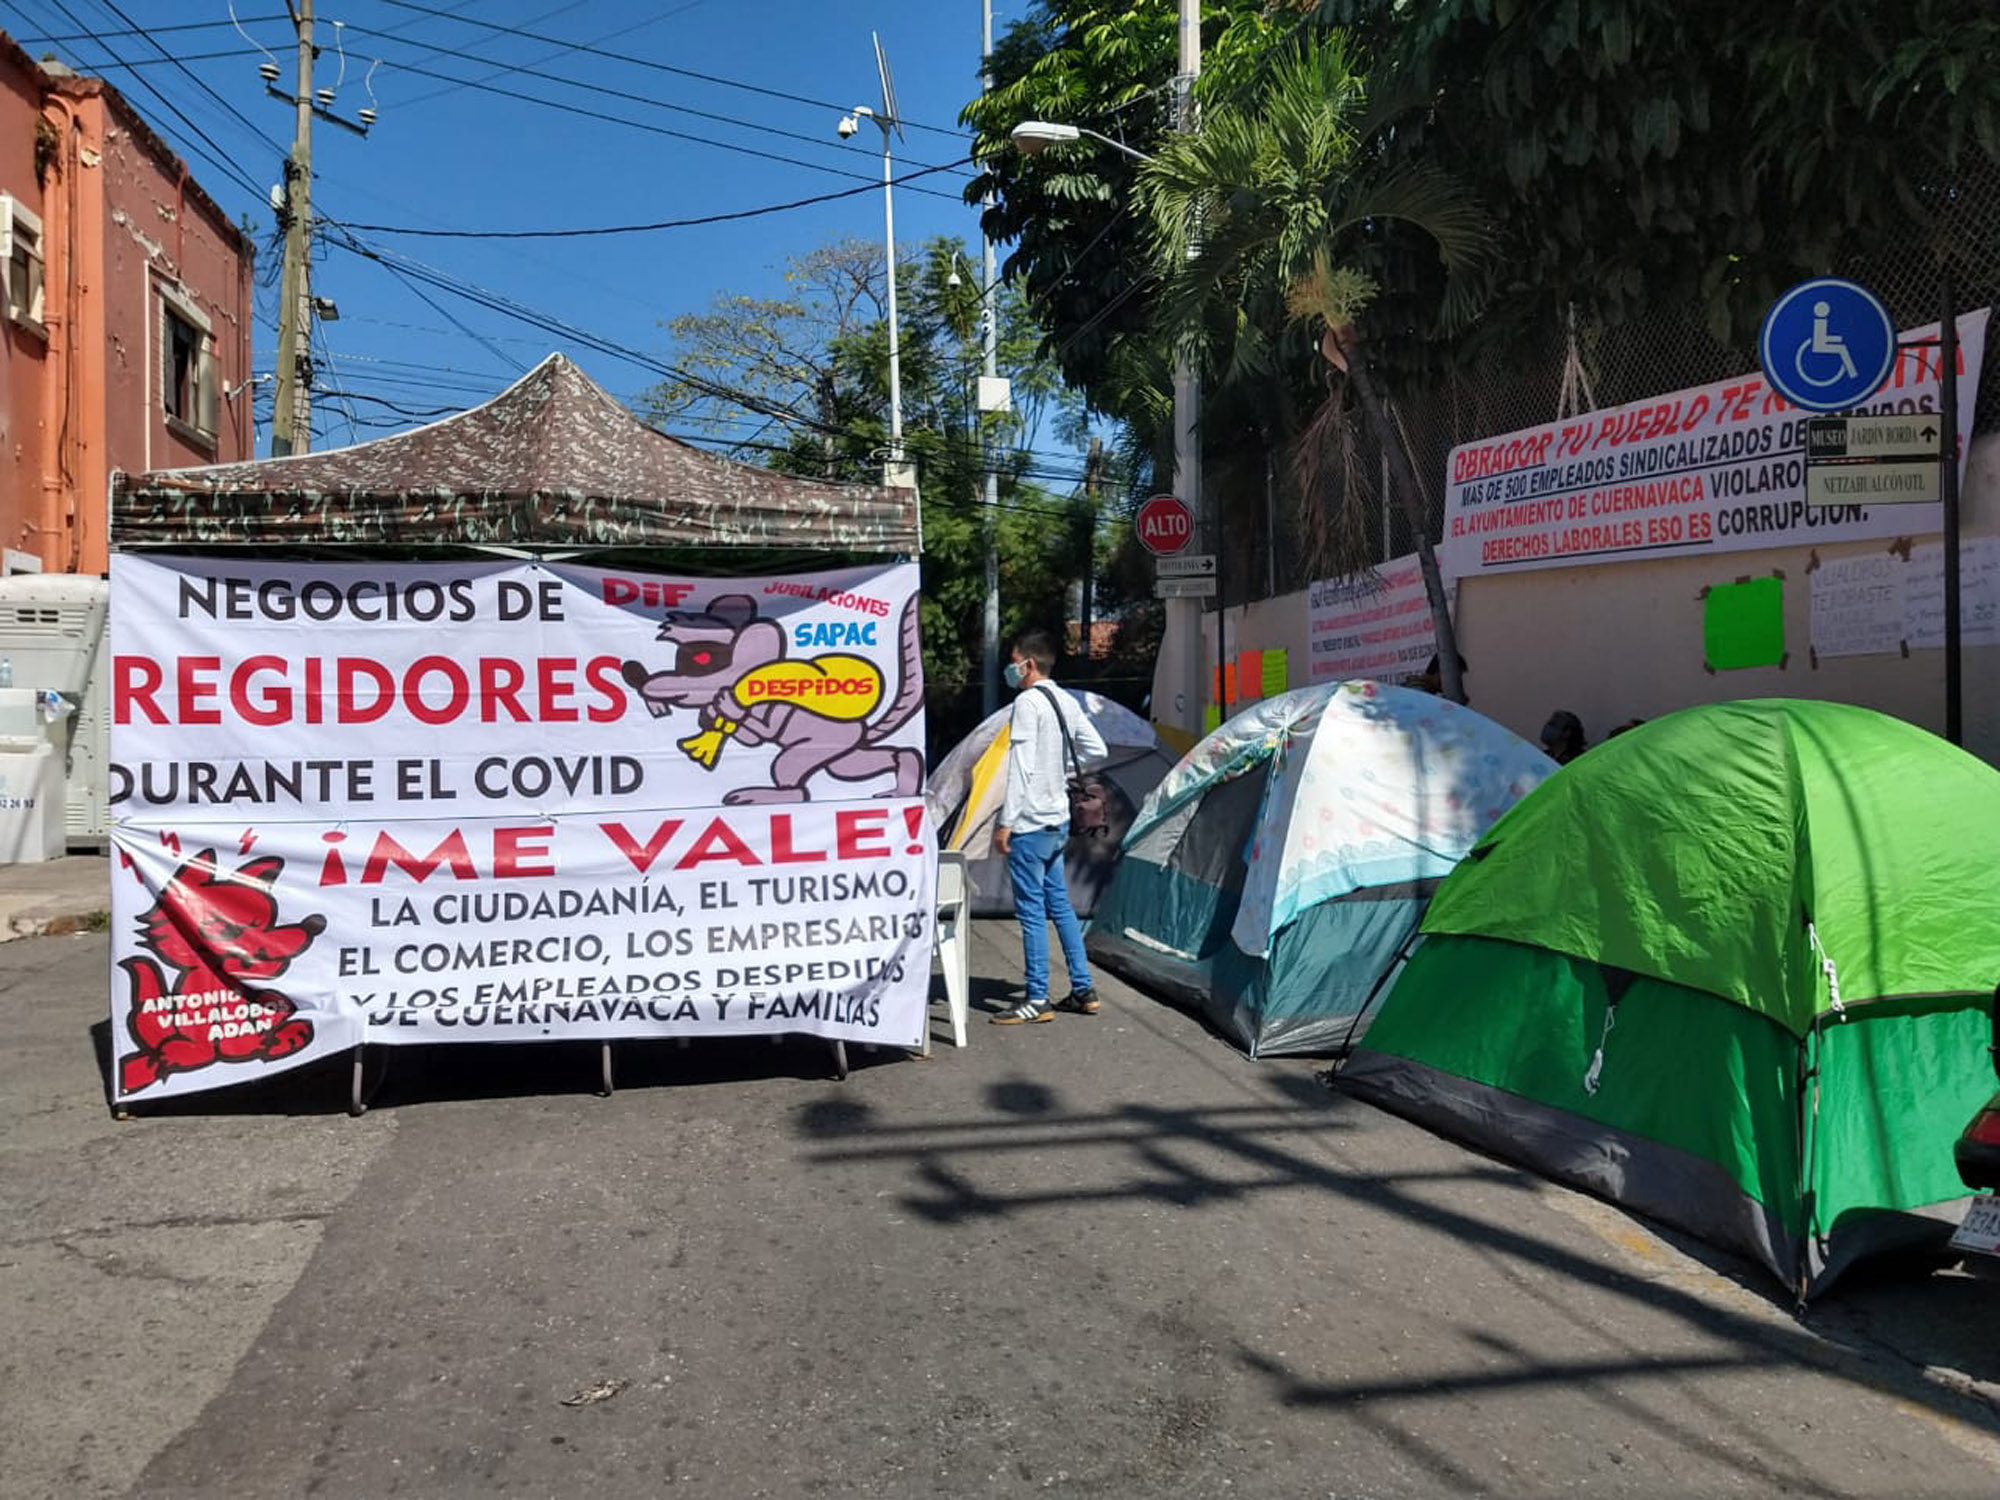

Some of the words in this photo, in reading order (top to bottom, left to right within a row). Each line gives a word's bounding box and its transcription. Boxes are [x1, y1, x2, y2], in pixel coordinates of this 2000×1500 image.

[1453, 431, 1554, 483] OBRADOR
[1556, 421, 1592, 459] TU
[1592, 394, 1710, 451] PUEBLO
[1715, 381, 1763, 425] TE
[1811, 428, 1847, 447] MUSEO
[1886, 425, 1918, 444] BORDA
[1486, 480, 1503, 501] DE
[1505, 474, 1527, 499] 500
[1530, 456, 1615, 495] EMPLEADOS
[1620, 425, 1773, 477] SINDICALIZADOS
[1468, 498, 1563, 534] AYUNTAMIENTO
[1568, 495, 1586, 520] DE
[1591, 475, 1705, 515] CUERNAVACA
[1710, 459, 1807, 499] VIOLARO
[1145, 513, 1188, 537] ALTO
[1482, 535, 1549, 562] DERECHOS
[1553, 520, 1642, 554] LABORALES
[1648, 515, 1682, 542] ESO
[1688, 512, 1711, 538] ES
[178, 575, 476, 622] NEGOCIOS
[499, 580, 565, 622] DE
[795, 621, 877, 647] SAPAC
[113, 655, 628, 727] REGIDORES
[109, 760, 375, 805] DURANTE
[397, 760, 457, 801] EL
[474, 756, 644, 799] COVID
[319, 825, 556, 887] ¡ME
[599, 805, 925, 875] VALE!
[371, 896, 421, 927] LA
[433, 877, 685, 925] CIUDADANÍA,
[700, 881, 738, 910] EL
[748, 869, 916, 906] TURISMO,
[339, 946, 380, 977] EL
[394, 934, 611, 975] COMERCIO,
[627, 928, 693, 959] LOS
[350, 993, 377, 1007] Y
[387, 986, 459, 1009] LOS
[474, 970, 702, 1006] EMPLEADOS
[368, 1008, 418, 1027] DE
[434, 994, 701, 1027] CUERNAVACA
[711, 991, 737, 1021] Y
[747, 988, 881, 1028] FAMILIAS
[207, 1018, 272, 1041] ADAN
